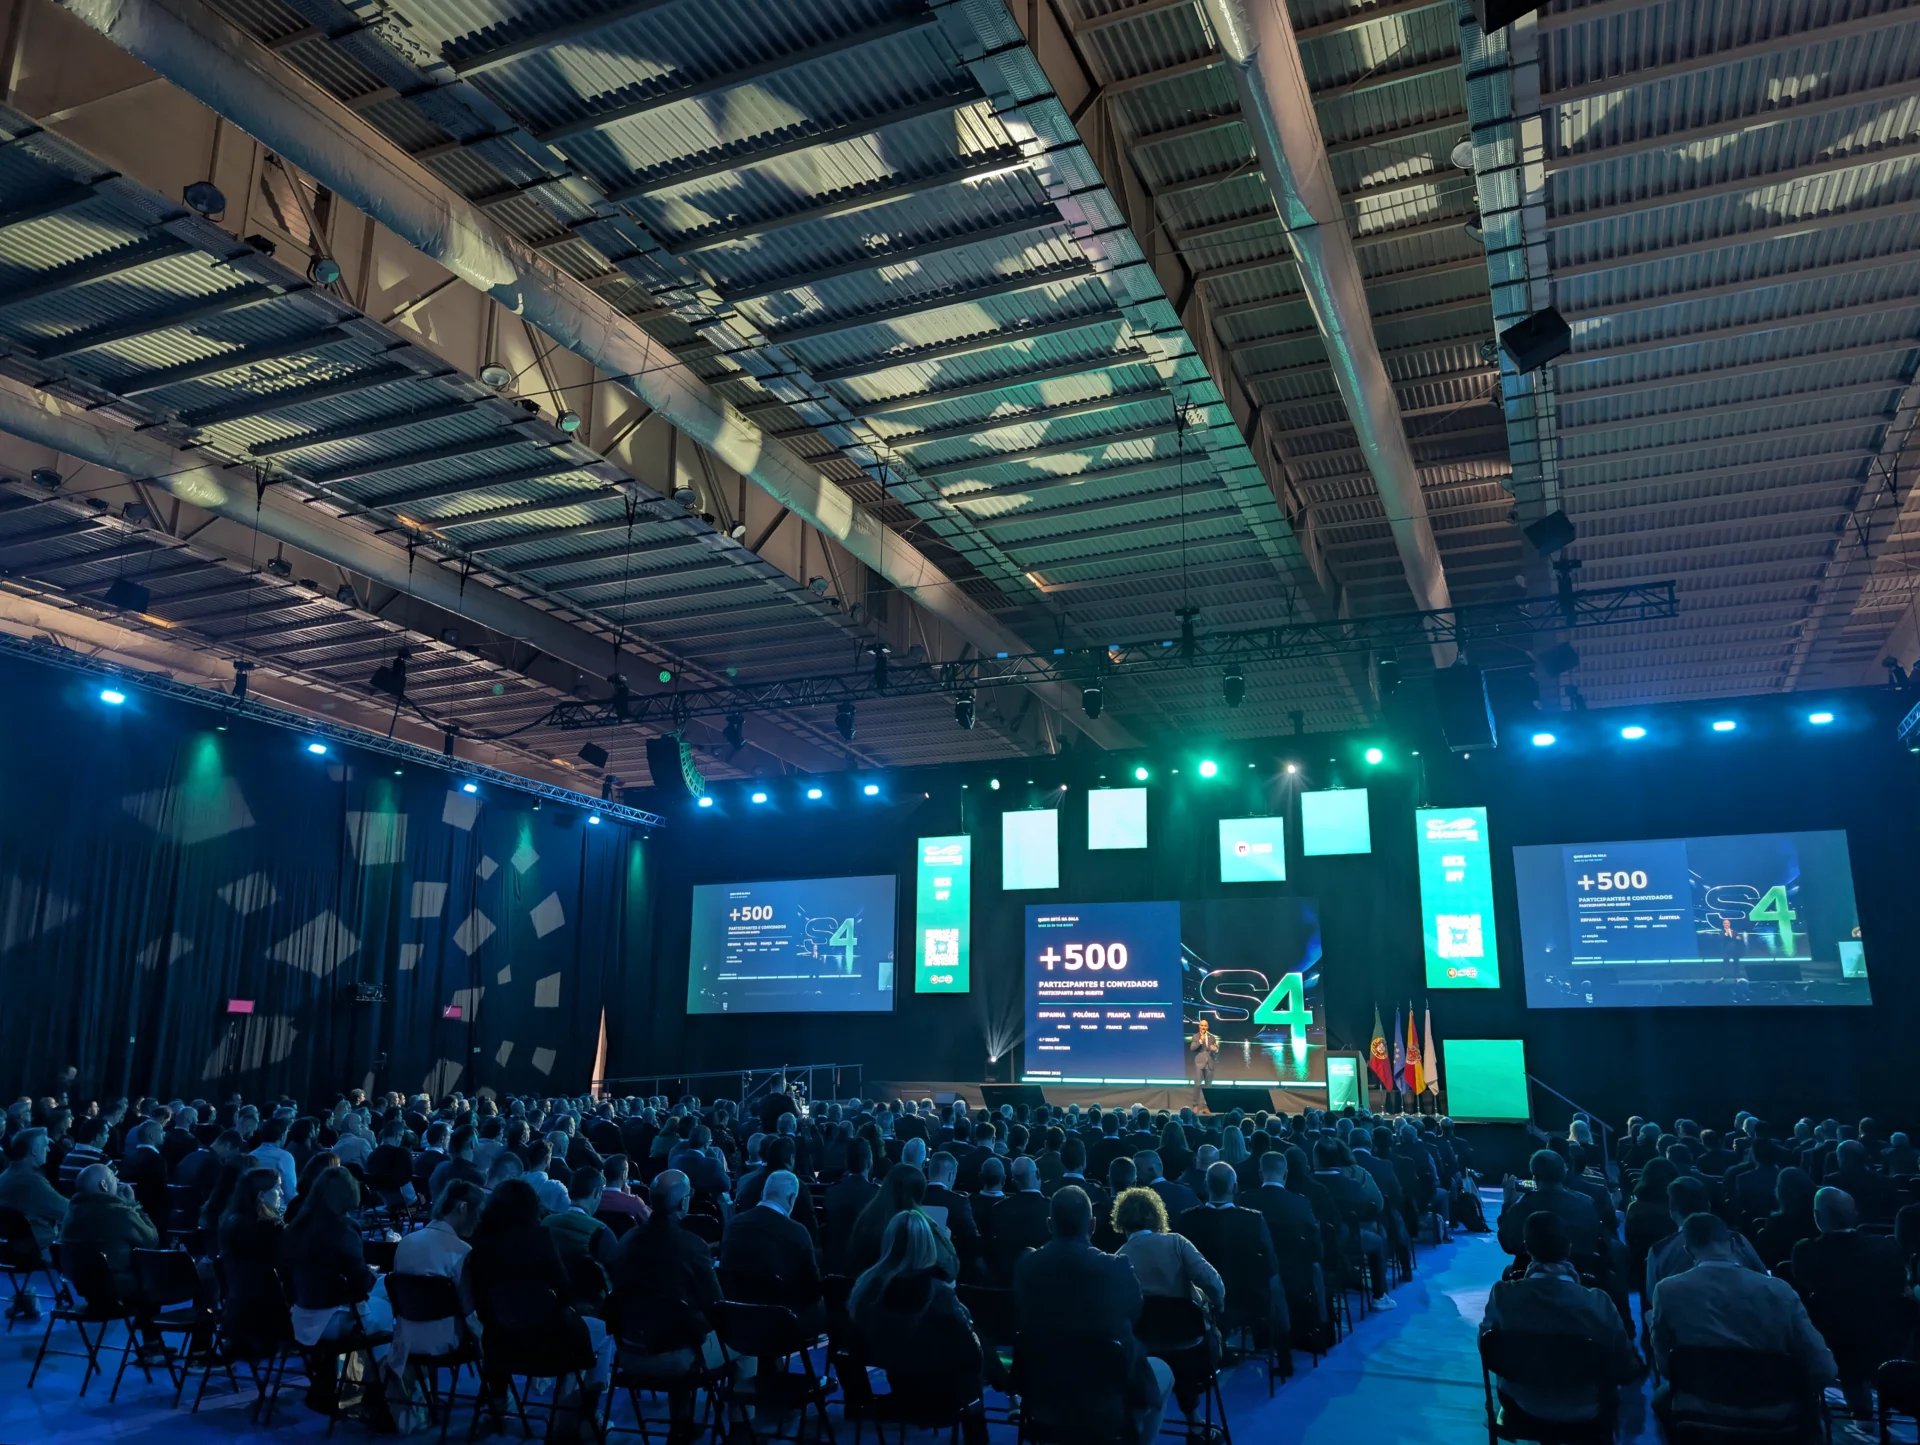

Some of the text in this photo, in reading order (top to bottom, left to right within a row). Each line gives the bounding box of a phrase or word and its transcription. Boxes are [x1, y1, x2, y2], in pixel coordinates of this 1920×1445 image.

[1578, 871, 1647, 890] +500
[729, 905, 773, 921] +500
[1705, 884, 1796, 933] S4
[803, 917, 857, 956] S4
[1040, 943, 1128, 970] +500
[1199, 969, 1313, 1041] S4
